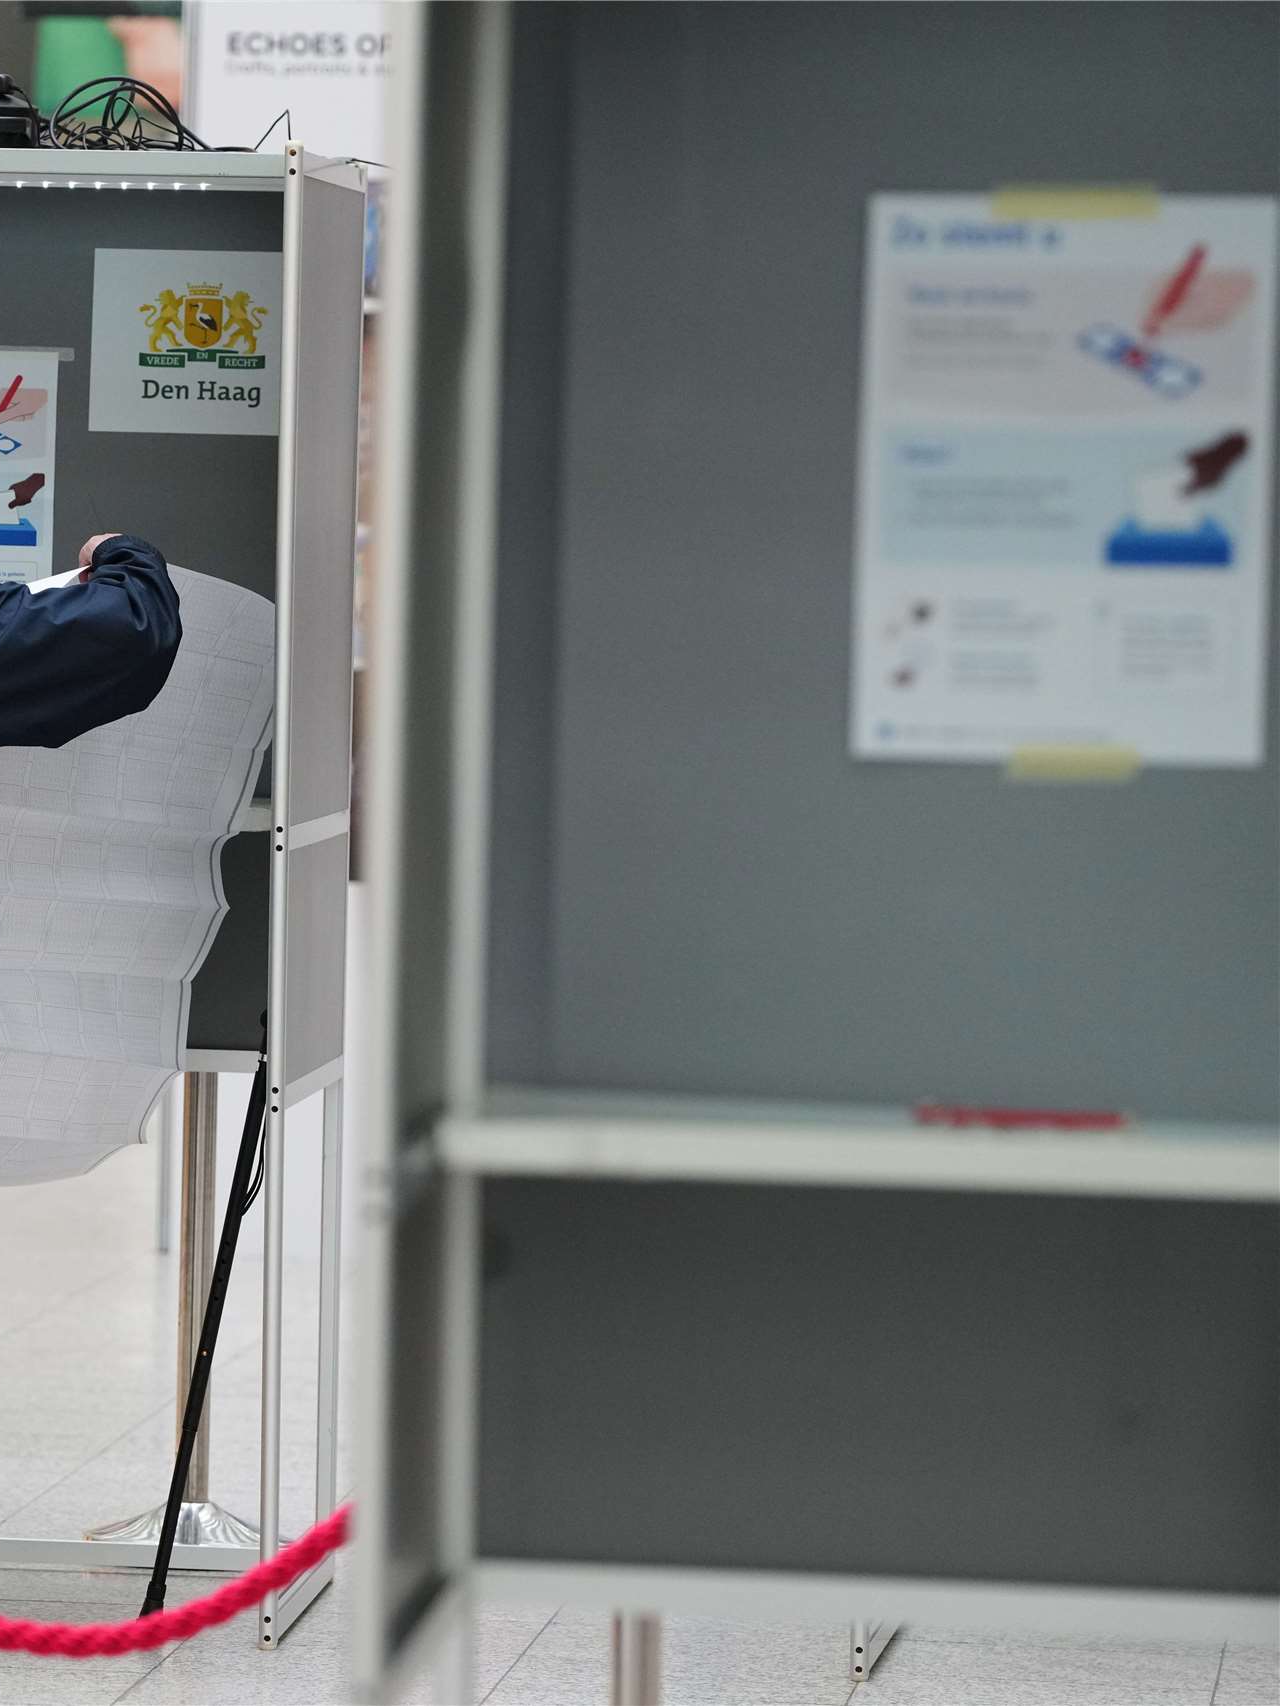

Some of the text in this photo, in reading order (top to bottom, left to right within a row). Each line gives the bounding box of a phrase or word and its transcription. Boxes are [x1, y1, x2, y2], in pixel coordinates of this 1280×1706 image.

[227, 32, 346, 57] ECHOES
[146, 352, 259, 367] VREDE EN RECHT
[141, 379, 262, 408] Den Haag
